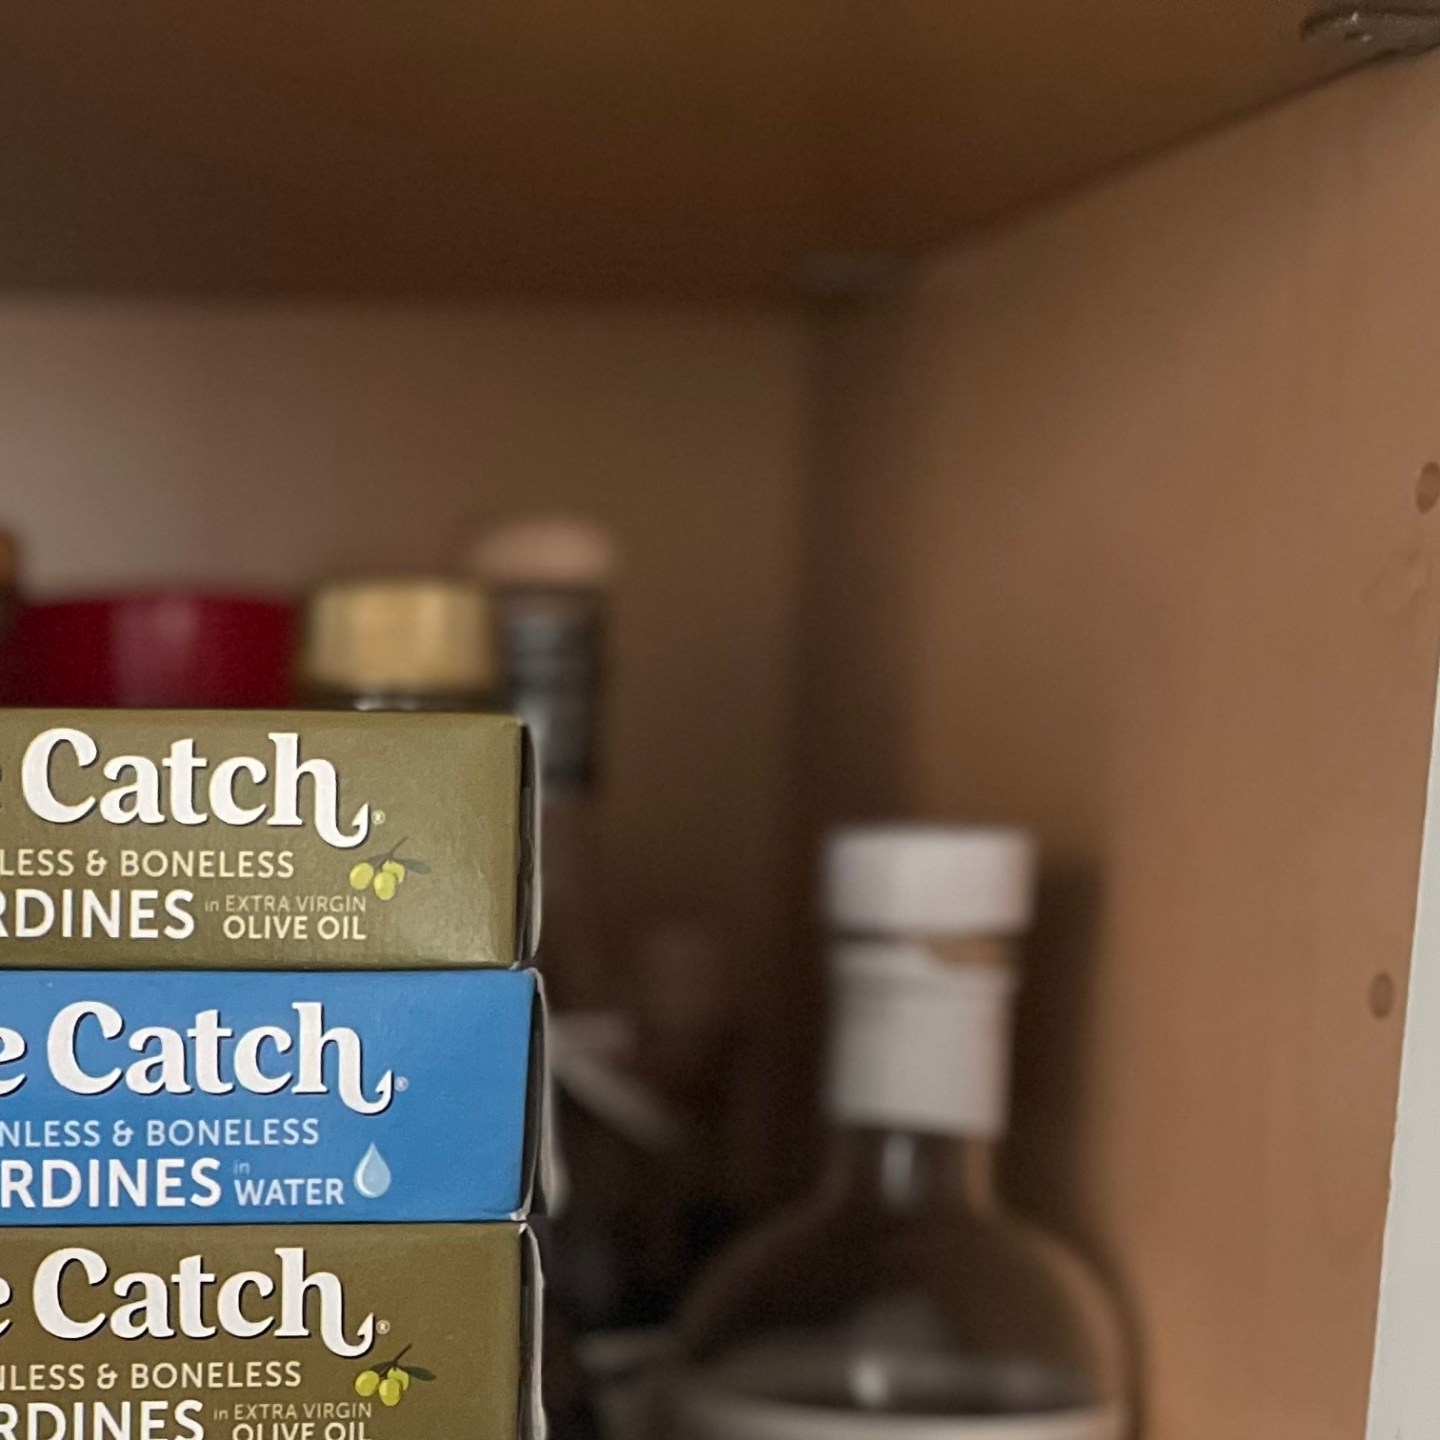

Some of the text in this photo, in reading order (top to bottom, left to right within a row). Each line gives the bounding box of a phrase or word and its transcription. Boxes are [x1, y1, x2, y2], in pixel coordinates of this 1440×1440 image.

[21, 727, 369, 848] Catch
[86, 849, 108, 877] &
[120, 849, 294, 879] BONELESS
[204, 899, 220, 912] in
[225, 894, 290, 913] EXTRA
[296, 894, 367, 914] VIRGIN
[223, 914, 367, 940] OLIVE OIL
[46, 1000, 392, 1114] Catch
[112, 1119, 134, 1147] &
[147, 1117, 319, 1147] BONELESS
[233, 1161, 250, 1175] in
[234, 1177, 345, 1206] WATER
[32, 1247, 374, 1357] Catch
[96, 1363, 118, 1390] &
[131, 1360, 301, 1389] BONELESS
[213, 1408, 229, 1421] in
[234, 1403, 297, 1421] EXTRA
[302, 1401, 372, 1419] VIRGIN
